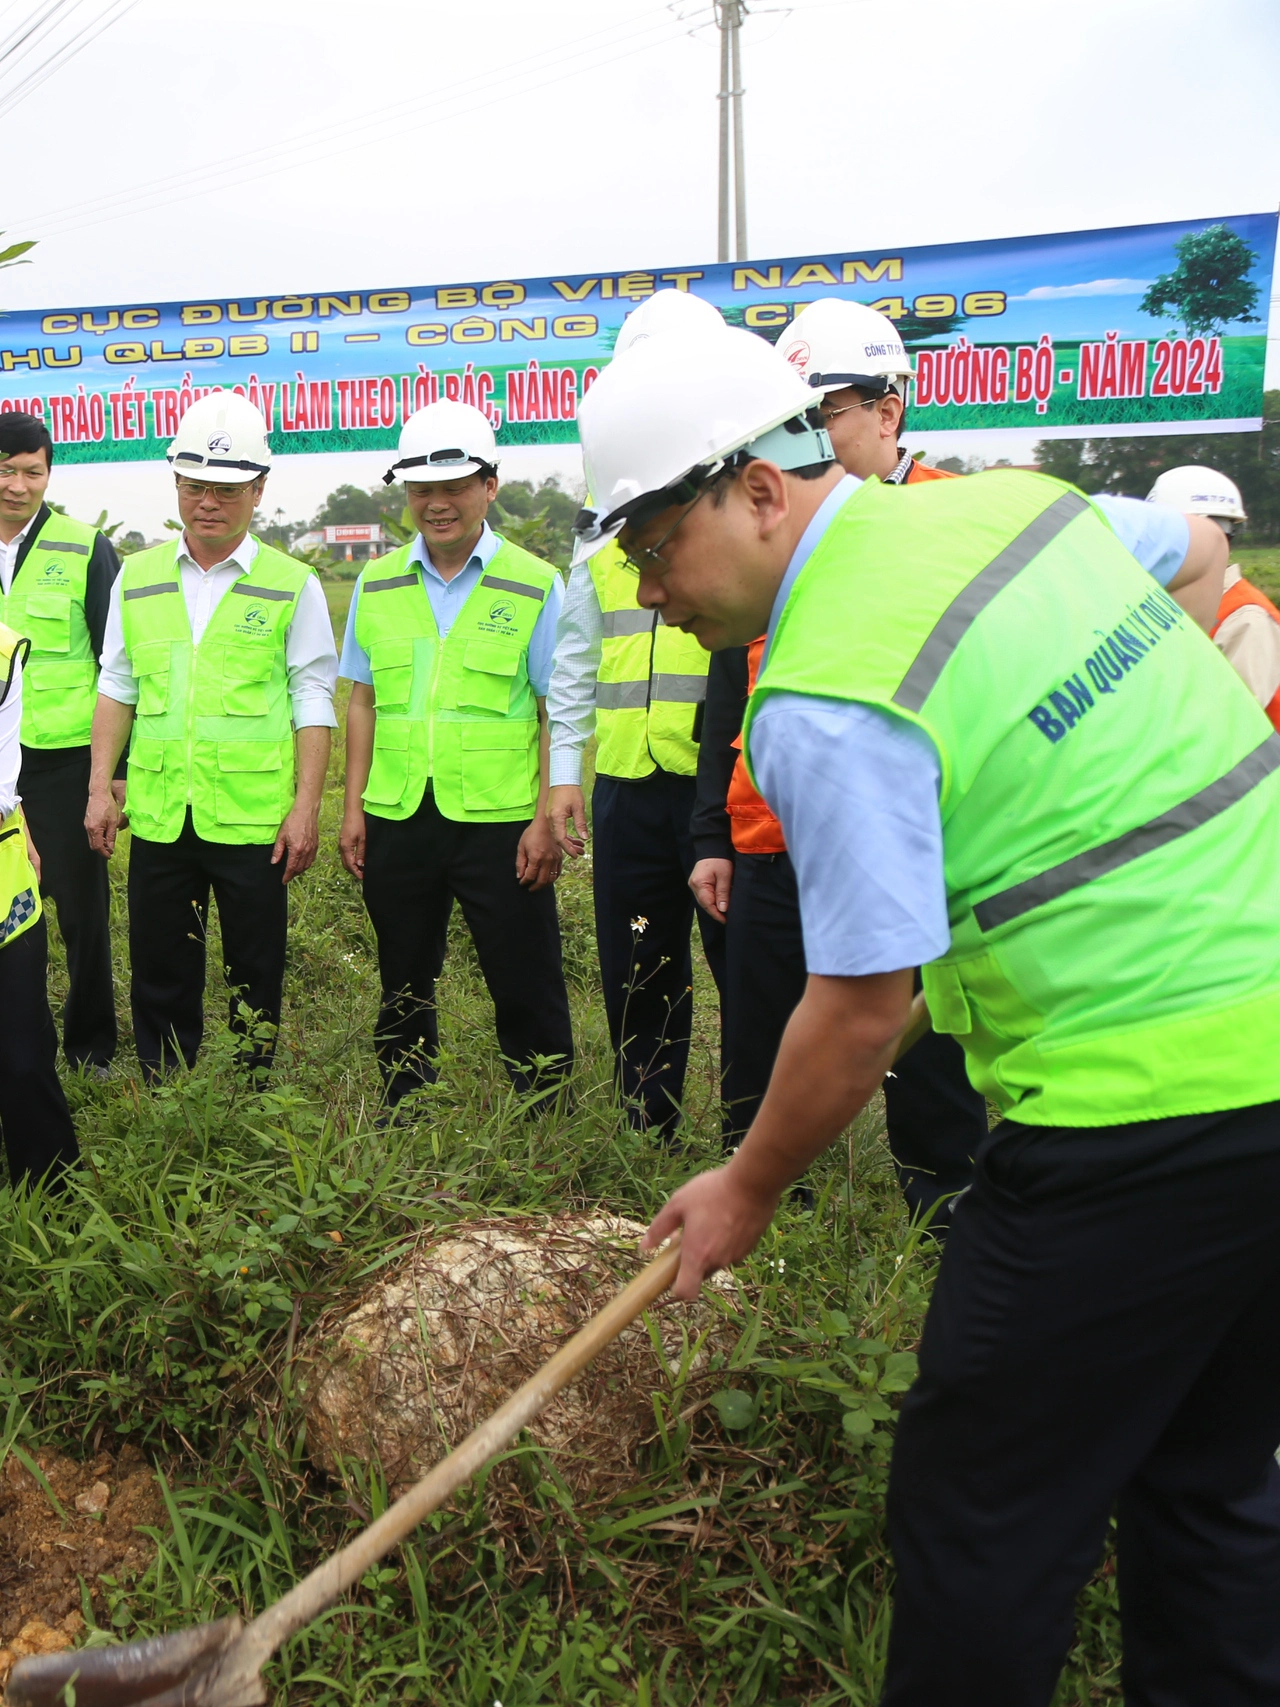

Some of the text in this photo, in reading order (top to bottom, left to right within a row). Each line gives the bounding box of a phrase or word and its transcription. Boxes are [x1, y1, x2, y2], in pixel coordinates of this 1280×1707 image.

[41, 257, 904, 335] CỤC ĐƯỜNG BỘ VIỆT NAM
[104, 334, 269, 364] QLĐB
[405, 313, 599, 347] CÔNG
[874, 291, 1006, 320] 496
[48, 383, 106, 443] TRÀO
[108, 375, 147, 440] TẾT
[151, 371, 224, 438] TRỒ
[232, 373, 276, 433] ÂY
[281, 372, 331, 433] LÀM
[335, 375, 395, 430] THEO
[506, 359, 577, 423] NÂNG
[914, 336, 1009, 407] ĐƯỜNG
[1014, 333, 1054, 415] BỘ
[1077, 330, 1148, 401] NĂM
[1150, 337, 1223, 396] 2024
[864, 343, 887, 358] CÔNG
[1027, 672, 1095, 745] BAN
[1083, 629, 1151, 695] QUẢN
[1125, 603, 1162, 647] LÝ
